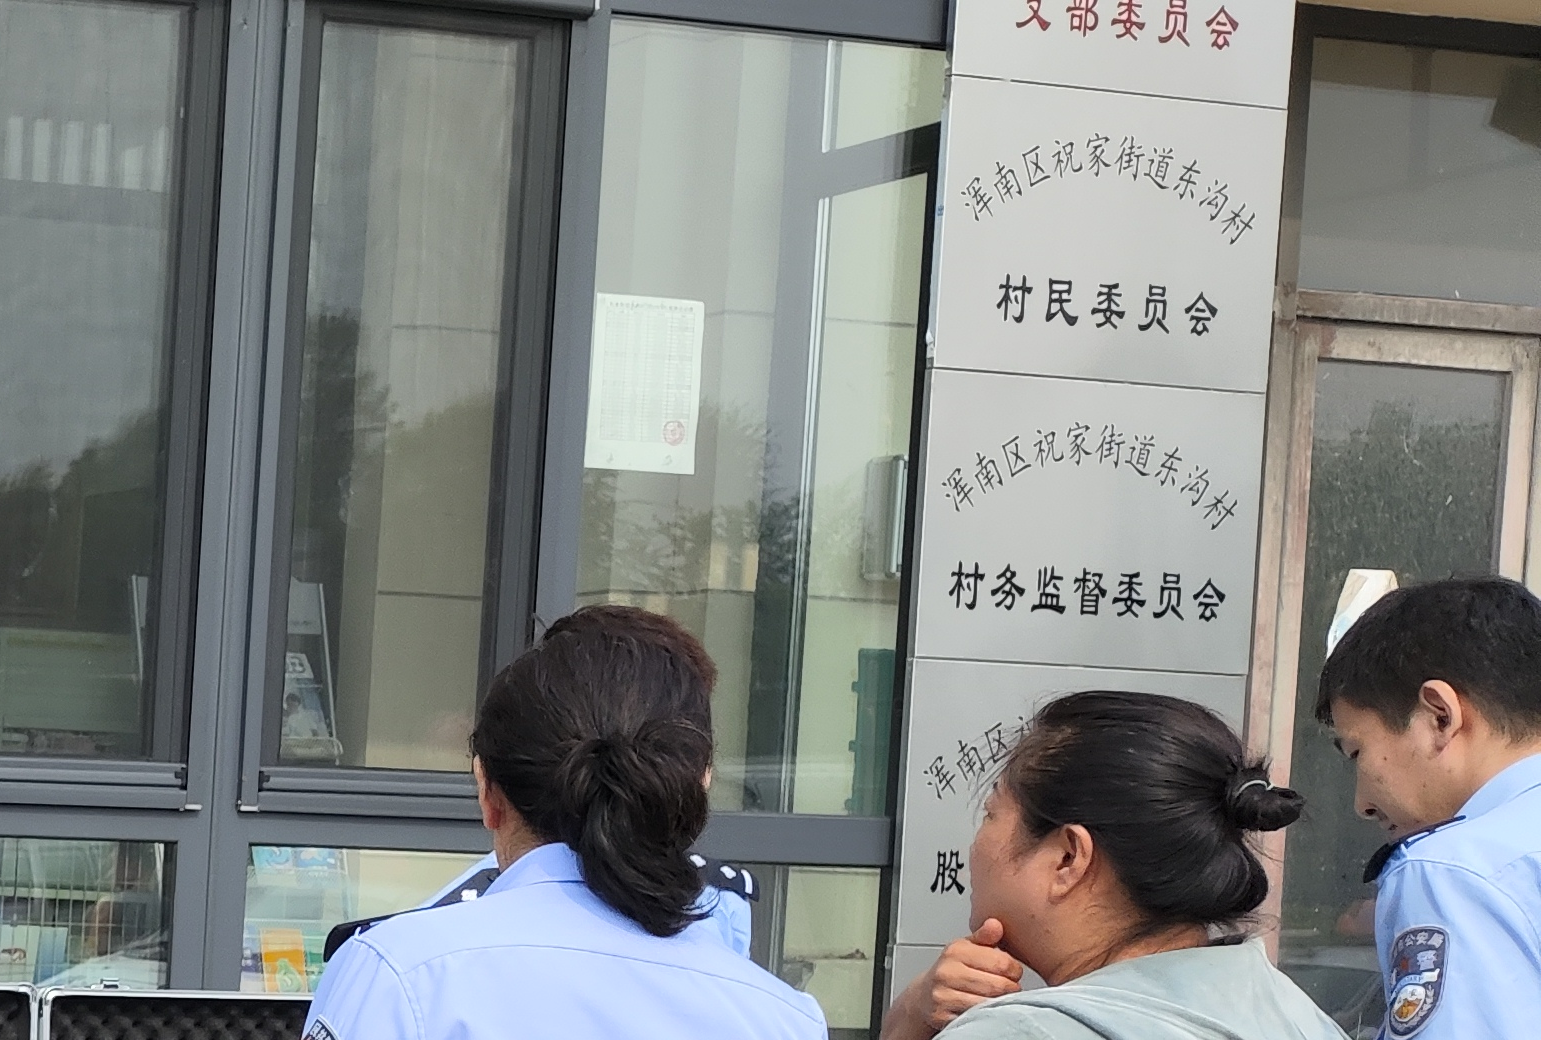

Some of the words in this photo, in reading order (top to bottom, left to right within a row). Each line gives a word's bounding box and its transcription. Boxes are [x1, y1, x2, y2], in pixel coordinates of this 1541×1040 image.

[960, 132, 1257, 246] 浑南区祝家街道东沟村
[996, 273, 1219, 337] 村民委员会
[940, 421, 1239, 531] 浑南区祝家街道东沟村
[948, 560, 1227, 623] 村务监督委员会
[923, 715, 1038, 800] 浑南区
[930, 849, 966, 896] 股
